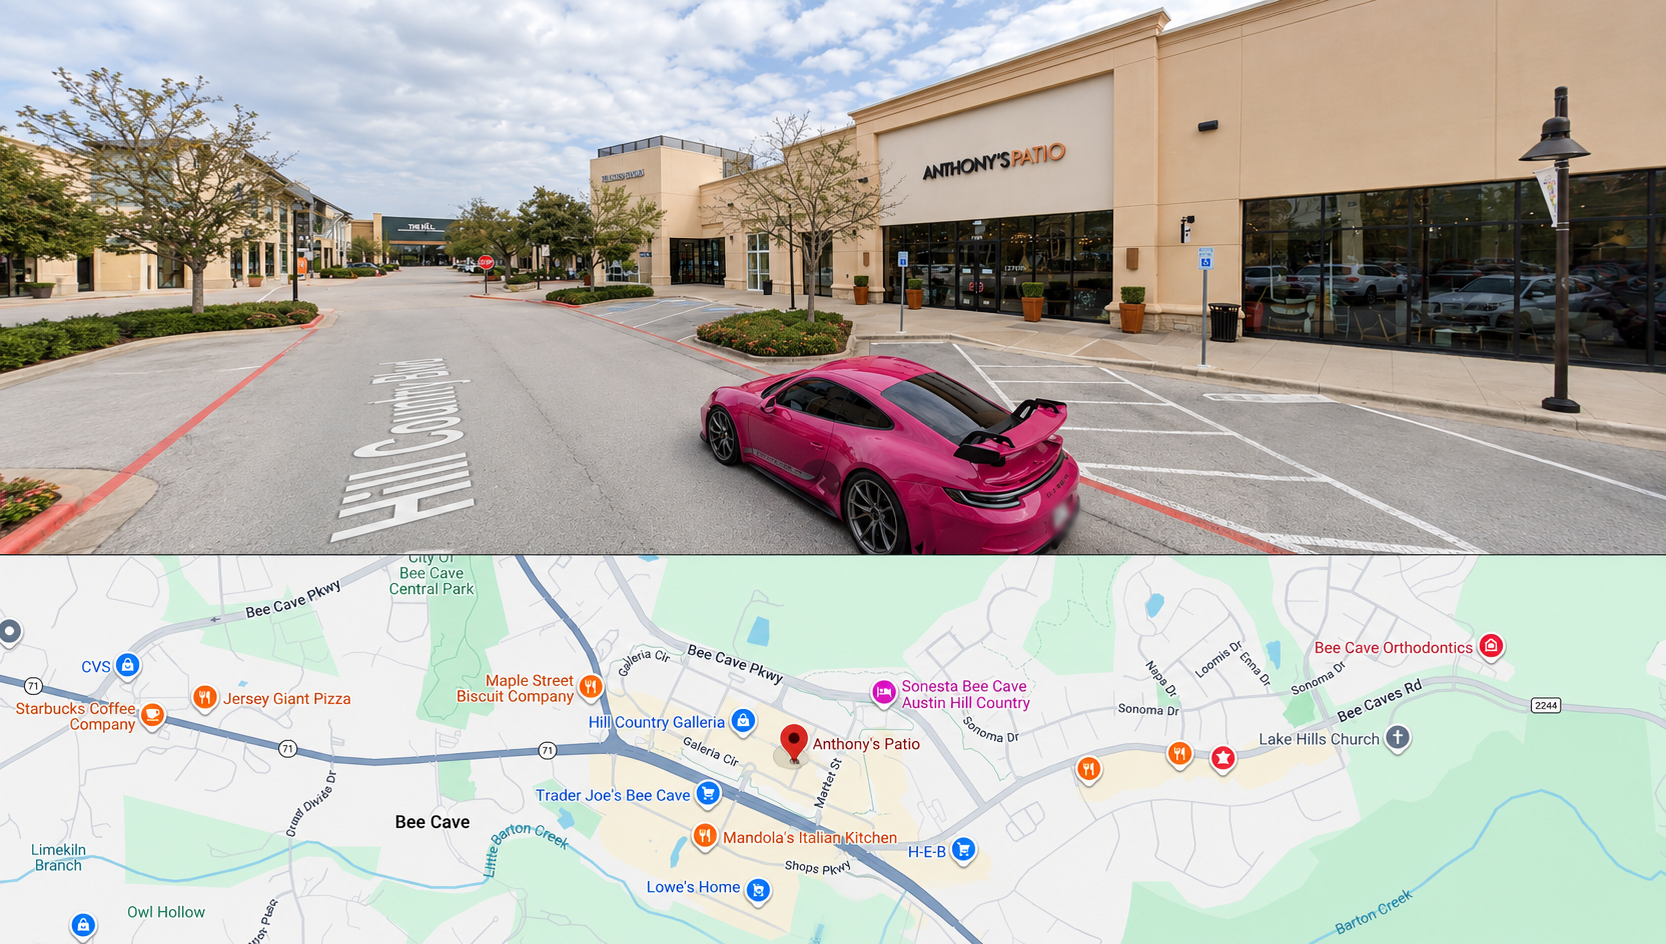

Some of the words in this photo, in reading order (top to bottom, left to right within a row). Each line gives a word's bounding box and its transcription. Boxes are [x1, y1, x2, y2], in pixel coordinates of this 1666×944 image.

[922, 152, 1010, 180] ANTHONY'S
[1011, 142, 1066, 167] PATIO
[400, 566, 426, 579] Bee
[430, 567, 464, 579] Cave
[390, 582, 438, 594] Central
[443, 582, 474, 594] Park
[245, 603, 271, 618] Bee
[273, 595, 306, 614] Cave
[306, 580, 341, 602] Pkwy
[1315, 641, 1341, 653] Bee
[1344, 641, 1379, 653] Cave
[1384, 640, 1473, 653] Orthodontics
[655, 650, 670, 662] Cir
[1195, 650, 1230, 678] Loomis
[1229, 641, 1242, 652] Dr
[82, 661, 111, 673] CVS
[687, 644, 714, 660] Bee
[716, 652, 747, 671] Cave
[749, 662, 784, 686] Pkwy
[1240, 652, 1261, 676] Enna
[1260, 674, 1270, 686] Dr
[486, 675, 528, 689] Maple
[532, 675, 574, 687] Street
[1146, 660, 1168, 686] Napa
[1166, 685, 1177, 698] Dr
[1291, 667, 1330, 695] Sonoma
[1332, 660, 1346, 676] Dr
[28, 682, 38, 690] 71
[902, 680, 958, 692] Sonesta
[963, 680, 990, 692] Bee
[993, 680, 1026, 692] Cave
[223, 692, 269, 708] Jersey
[273, 692, 309, 705] Giant
[314, 692, 351, 705] Pizza
[457, 690, 503, 702] Biscuit
[508, 690, 574, 706] Company
[902, 697, 946, 709] Austin
[950, 697, 972, 709] Hill
[976, 697, 1030, 712] Country
[1338, 705, 1362, 722] Bee
[1364, 689, 1402, 714] Caves
[1405, 679, 1422, 695] Rd
[16, 703, 85, 715] Starbucks
[90, 703, 135, 715] Coffee
[1118, 704, 1163, 715] Sonoma
[1168, 706, 1179, 716] Dr
[1536, 701, 1558, 710] 2244
[70, 718, 135, 732] Company
[589, 716, 611, 728] Hill
[614, 716, 669, 732] Country
[673, 716, 725, 728] Galleria
[964, 716, 1003, 742] Sonoma
[1006, 732, 1020, 742] Dr
[813, 738, 882, 752] Anthony's
[886, 738, 920, 750] Patio
[1259, 732, 1291, 745] Lake
[1297, 732, 1327, 745] Hills
[1332, 732, 1380, 745] Church
[282, 744, 292, 753] 71
[542, 746, 553, 754] 71
[684, 737, 720, 760] Galeria
[724, 754, 739, 766] Cir
[830, 758, 842, 770] St
[326, 770, 336, 783] Dr
[536, 789, 581, 801] Trader
[585, 789, 622, 801] Joe's
[626, 789, 652, 801] Bee
[657, 789, 690, 801] Cave
[396, 816, 426, 829] Bee
[431, 816, 470, 829] Cave
[490, 824, 531, 845] Barton
[535, 825, 568, 850] Creek
[724, 832, 794, 844] Mandola's
[799, 832, 841, 844] Italian
[846, 832, 897, 844] Kitchen
[31, 844, 86, 856] Limekiln
[908, 846, 946, 858] H-E-B
[35, 860, 82, 871] Branch
[785, 860, 818, 874] Shops
[647, 882, 694, 893] Lowe's
[699, 882, 740, 893] Home
[128, 906, 153, 918] Owl
[158, 906, 205, 918] Hollow
[1335, 910, 1376, 935] Barton
[1377, 890, 1413, 919] Creek
